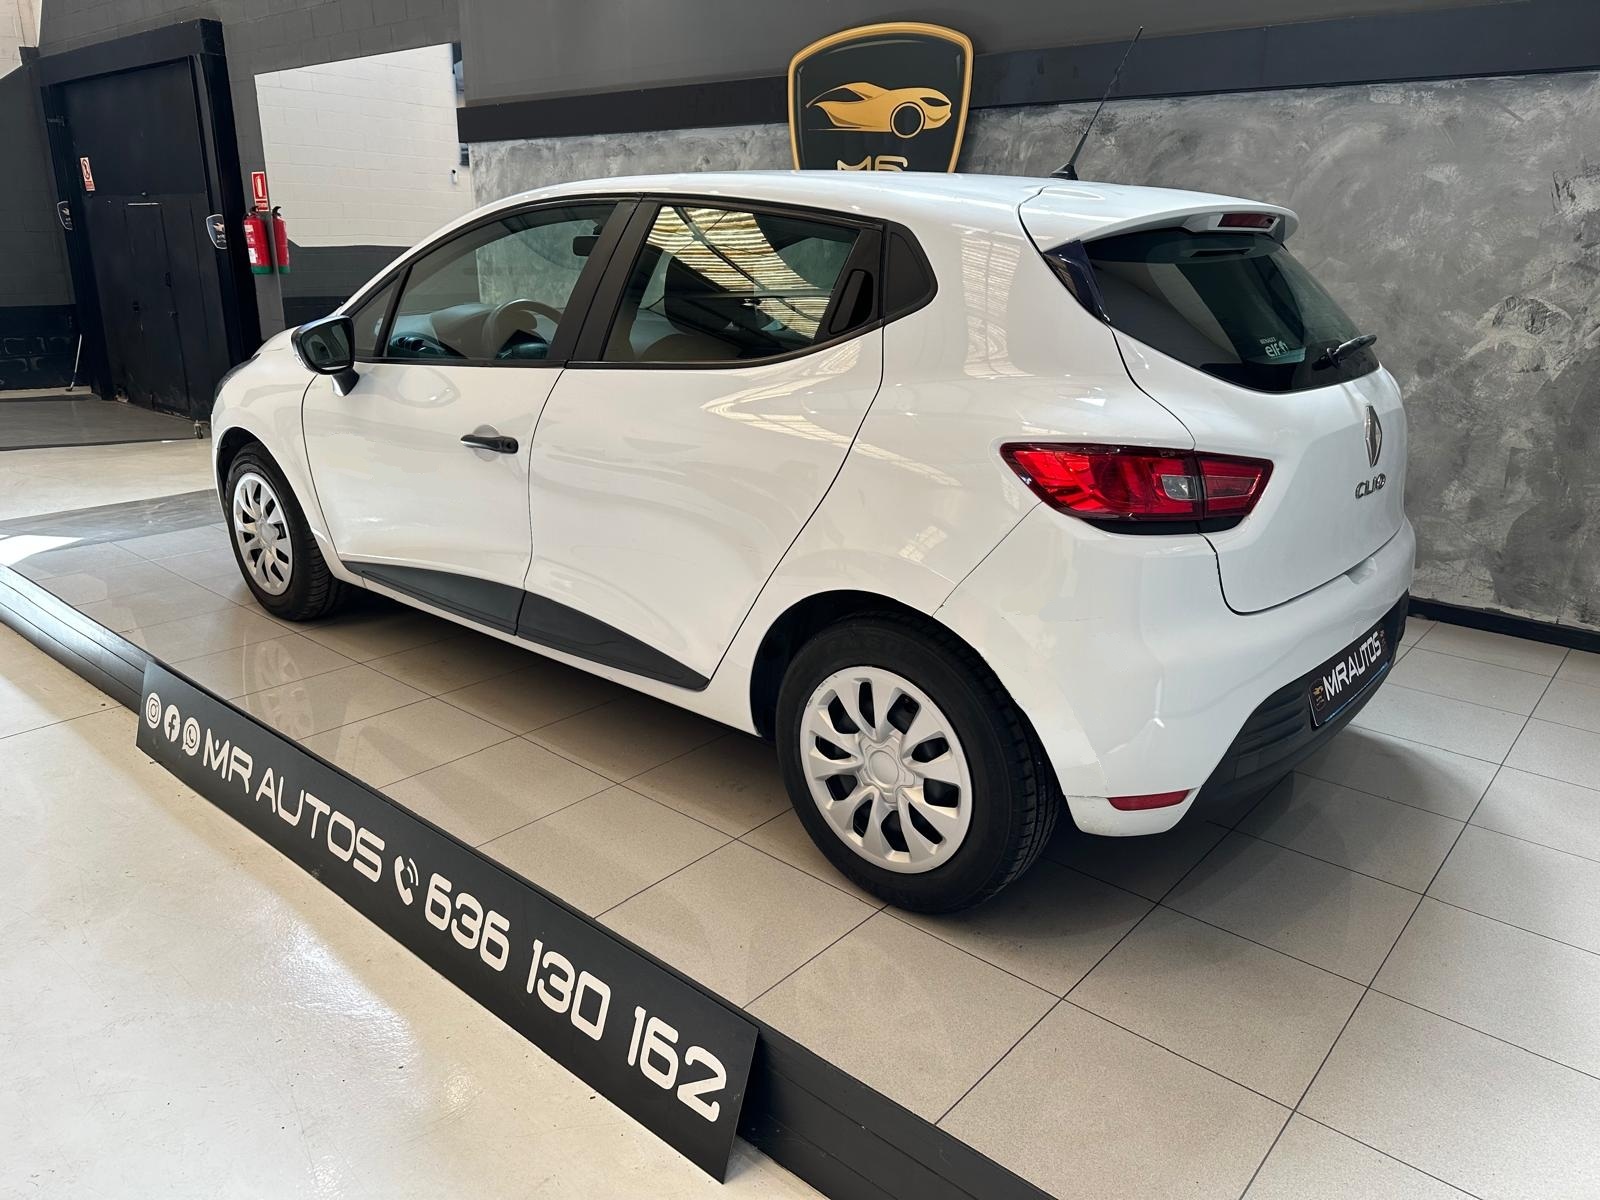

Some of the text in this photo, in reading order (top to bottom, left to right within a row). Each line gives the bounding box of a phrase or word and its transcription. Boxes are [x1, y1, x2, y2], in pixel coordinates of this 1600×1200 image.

[1355, 473, 1386, 499] CLIO
[203, 728, 727, 1123] MR AUTOS 636 130 162
